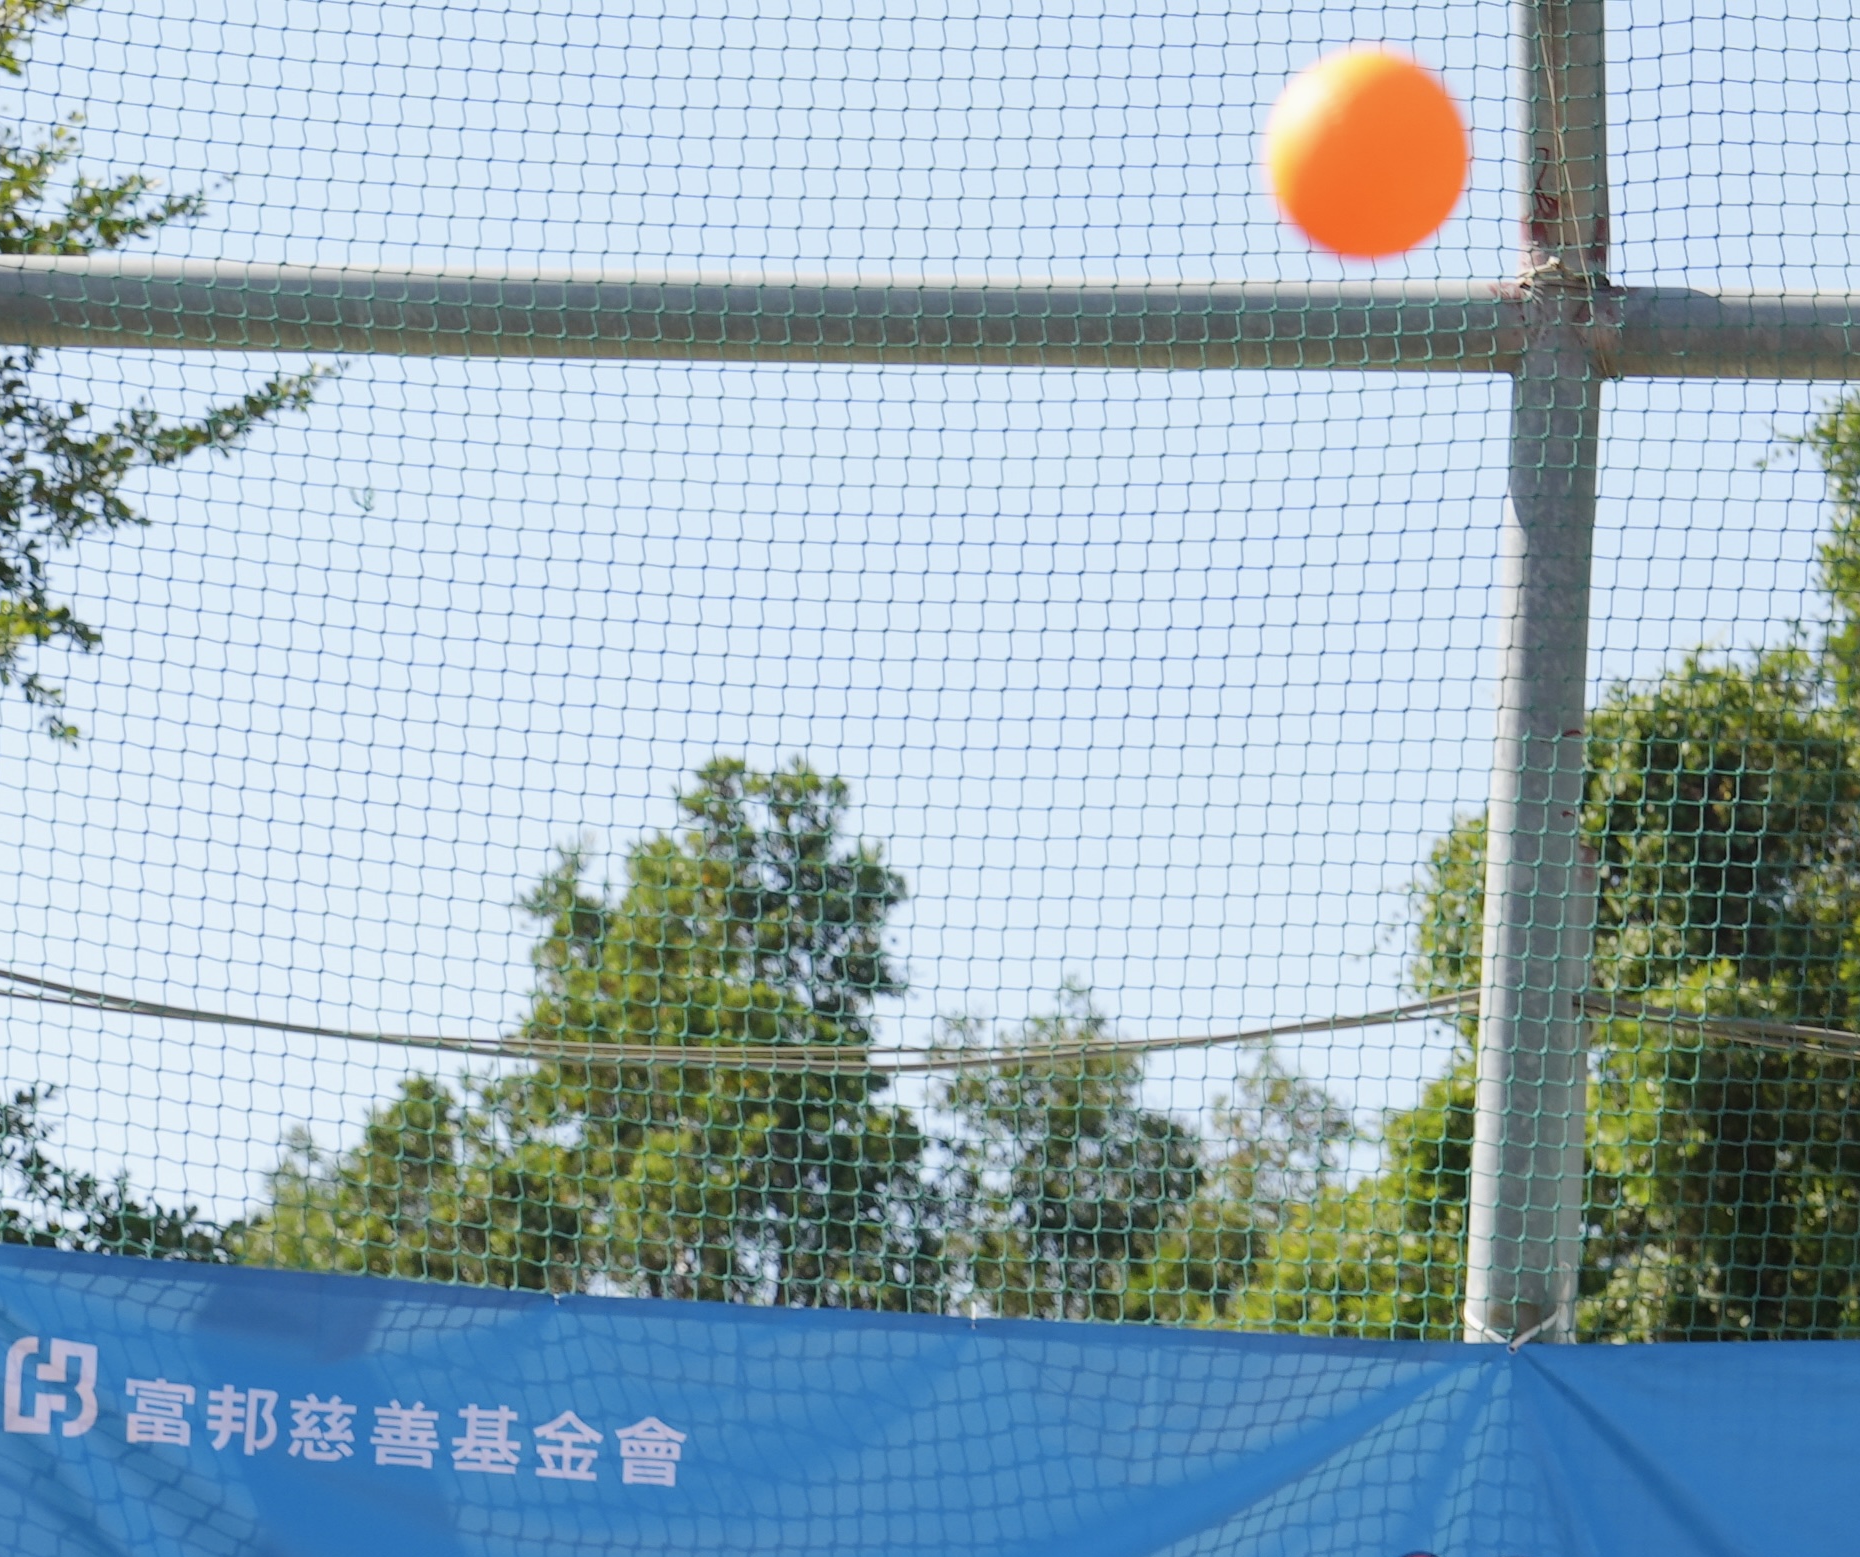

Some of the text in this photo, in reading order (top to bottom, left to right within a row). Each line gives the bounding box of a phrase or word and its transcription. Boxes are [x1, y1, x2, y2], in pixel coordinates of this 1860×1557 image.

[124, 1377, 687, 1487] 富邦慈善基金會
